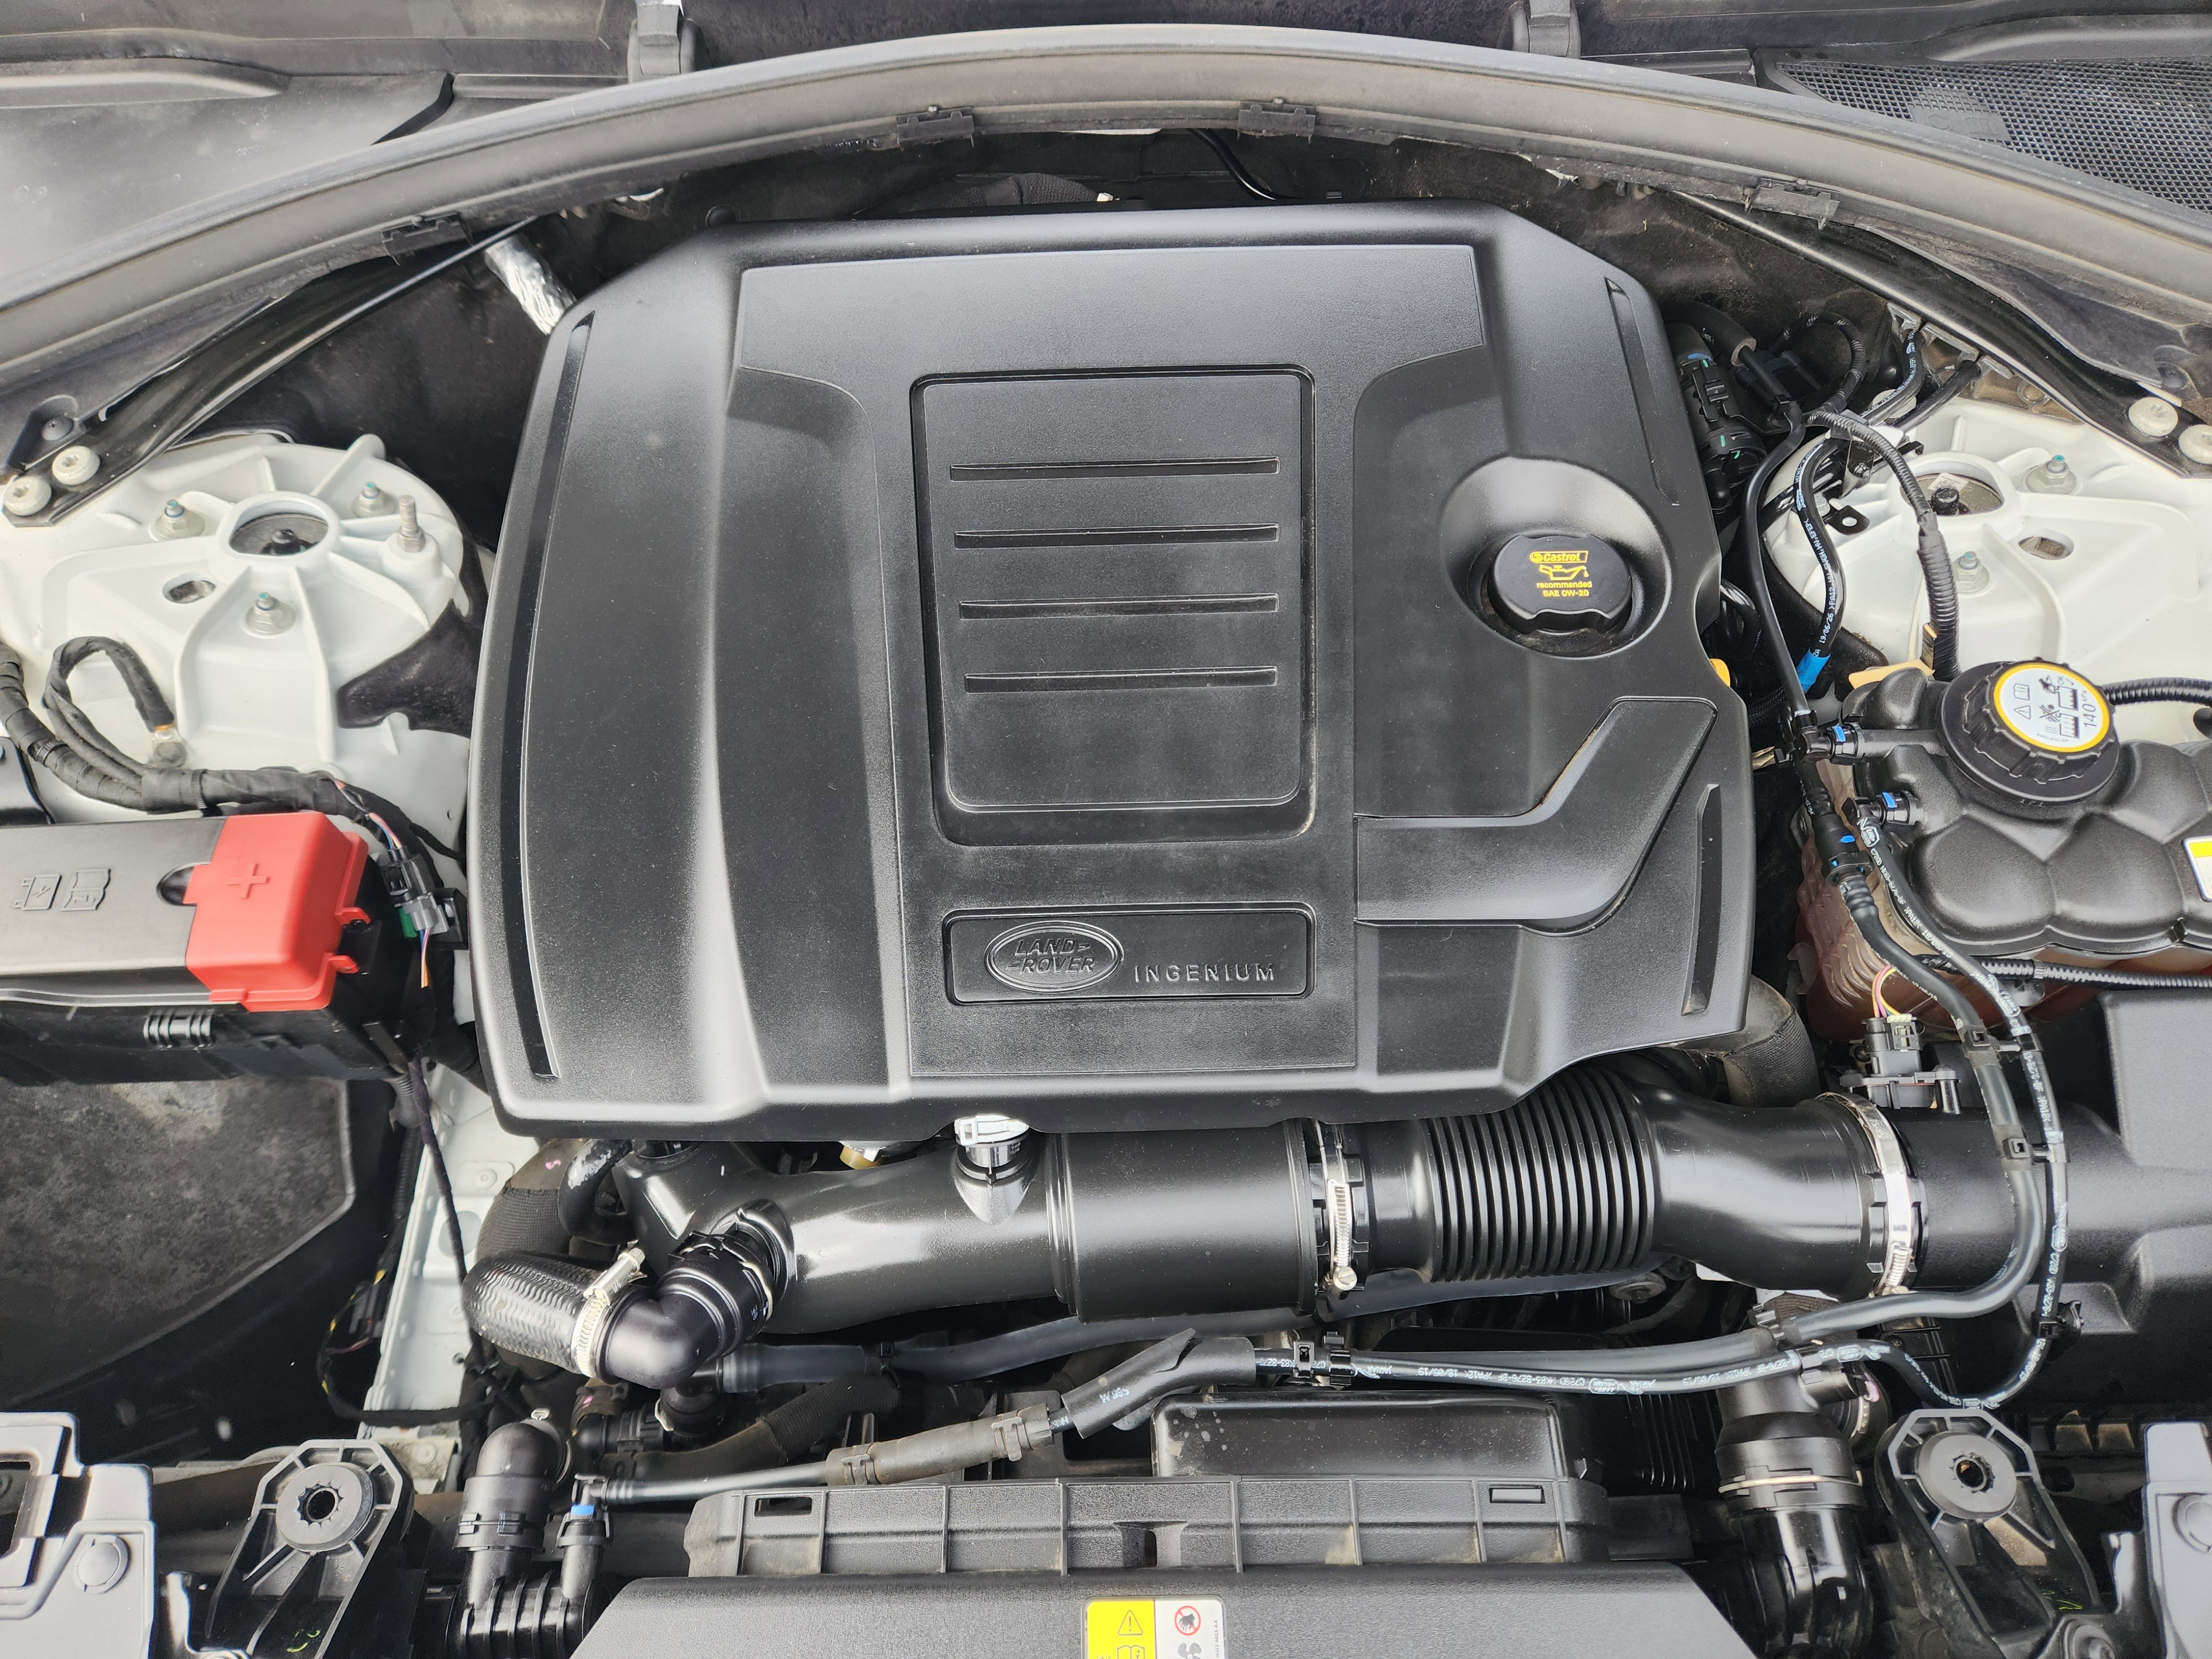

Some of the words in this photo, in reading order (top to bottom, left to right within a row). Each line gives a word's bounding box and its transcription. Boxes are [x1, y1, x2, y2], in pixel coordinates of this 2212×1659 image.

[1543, 552, 1581, 562] Castrol
[2057, 676, 2065, 685] OK
[2082, 703, 2097, 727] 140
[1014, 938, 1076, 957] LAND
[1019, 957, 1094, 975] ROVER
[1134, 963, 1275, 983] INGENIUM
[1367, 1365, 1392, 1375] JAGUAR
